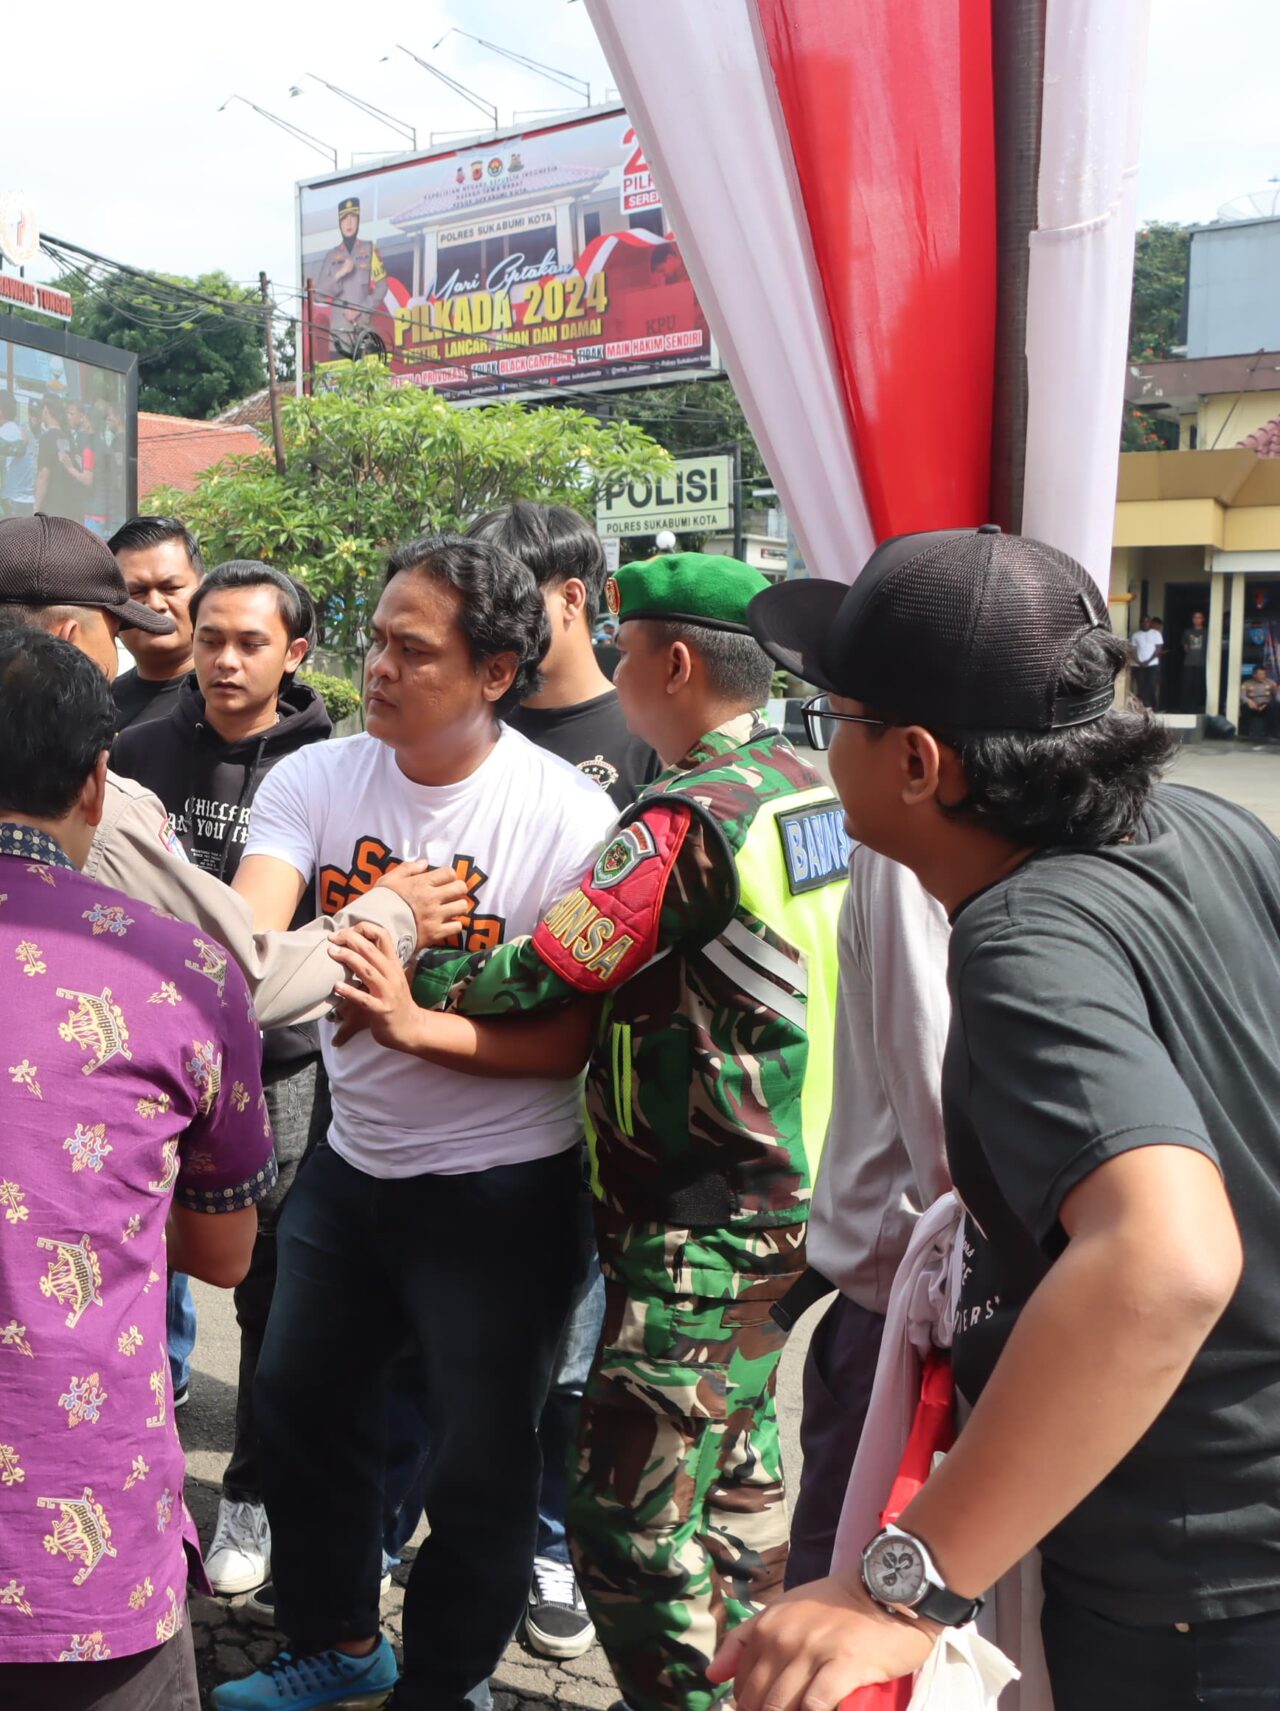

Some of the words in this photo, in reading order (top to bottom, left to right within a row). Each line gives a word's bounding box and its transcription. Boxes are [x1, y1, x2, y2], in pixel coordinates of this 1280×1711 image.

[440, 228, 474, 243] POLRES
[477, 218, 525, 235] SUKABUMI
[528, 213, 552, 225] KOTA
[424, 268, 480, 300] Mari
[486, 248, 573, 299] Ciptakan
[394, 288, 513, 347] PILKADA
[523, 271, 609, 326] 2024
[646, 313, 677, 335] KPU
[495, 330, 530, 350] AMAN
[533, 325, 558, 345] DAN
[561, 318, 602, 340] DAMAI
[500, 356, 527, 374] BLACK
[577, 345, 603, 363] TIDAK
[606, 341, 631, 359] MAIN
[632, 335, 665, 355] HAKIM
[665, 330, 702, 350] SENDIRI
[606, 468, 717, 510] POLISI
[606, 521, 642, 533] POLRES
[643, 518, 691, 530] SUKABUMI
[693, 515, 718, 526] KOTA
